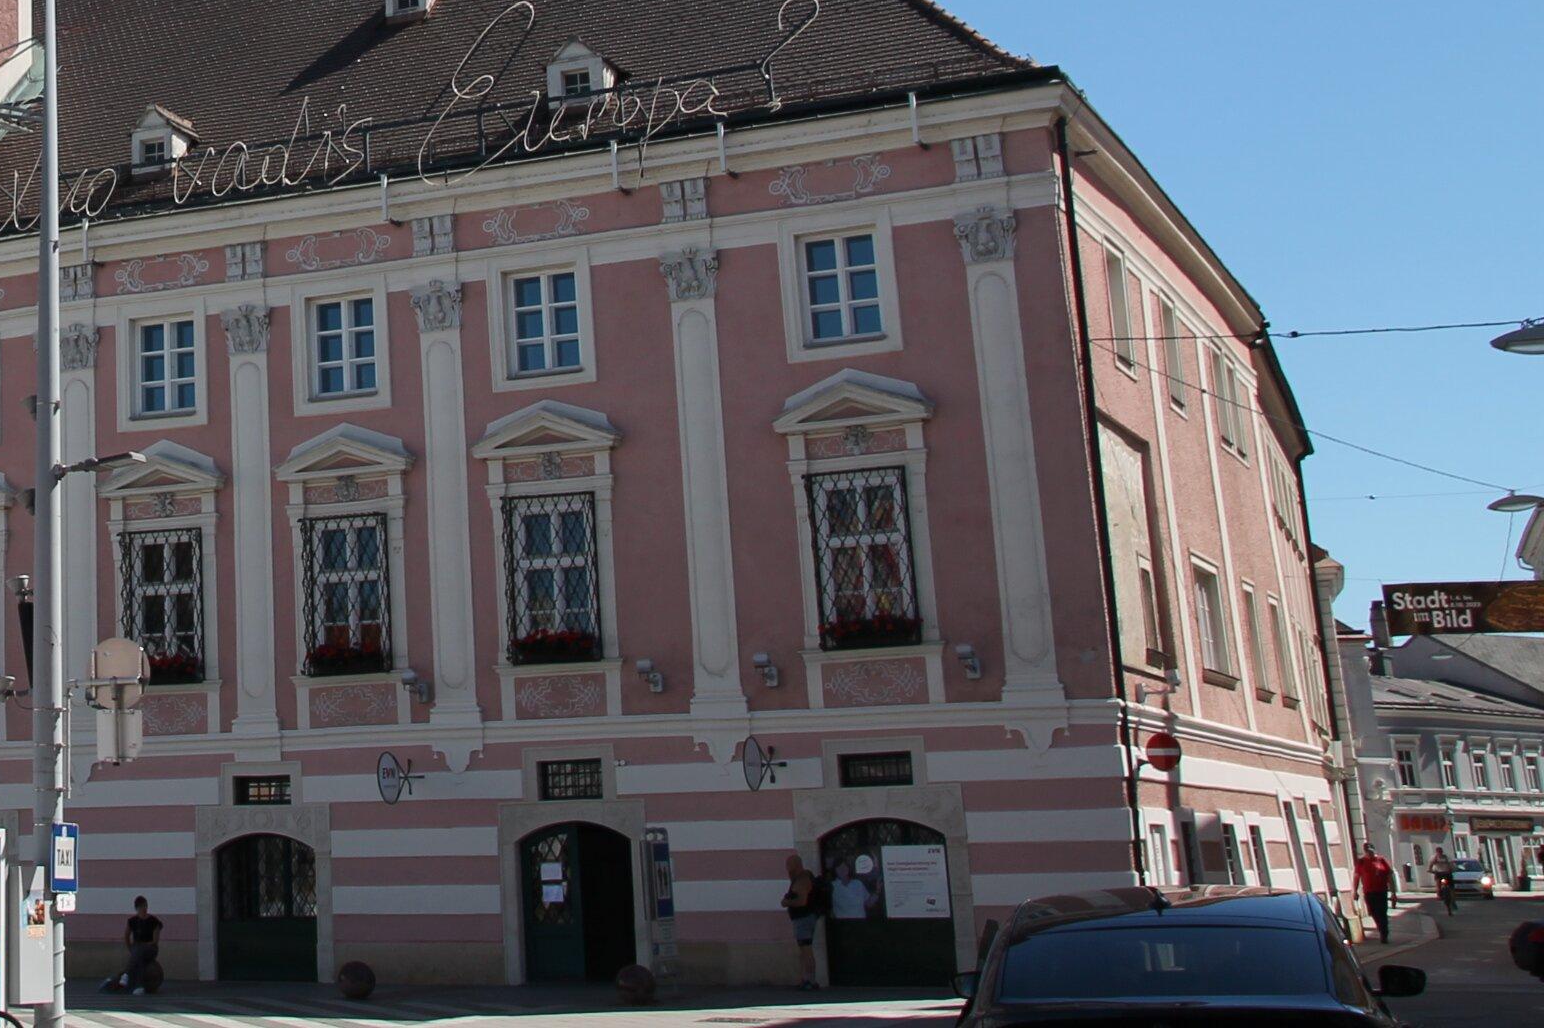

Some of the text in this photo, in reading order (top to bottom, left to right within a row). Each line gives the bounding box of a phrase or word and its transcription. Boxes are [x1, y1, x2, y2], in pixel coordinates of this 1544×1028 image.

[1392, 590, 1449, 610] Stadt
[1413, 609, 1472, 628] im Bild
[57, 848, 72, 867] TAXI
